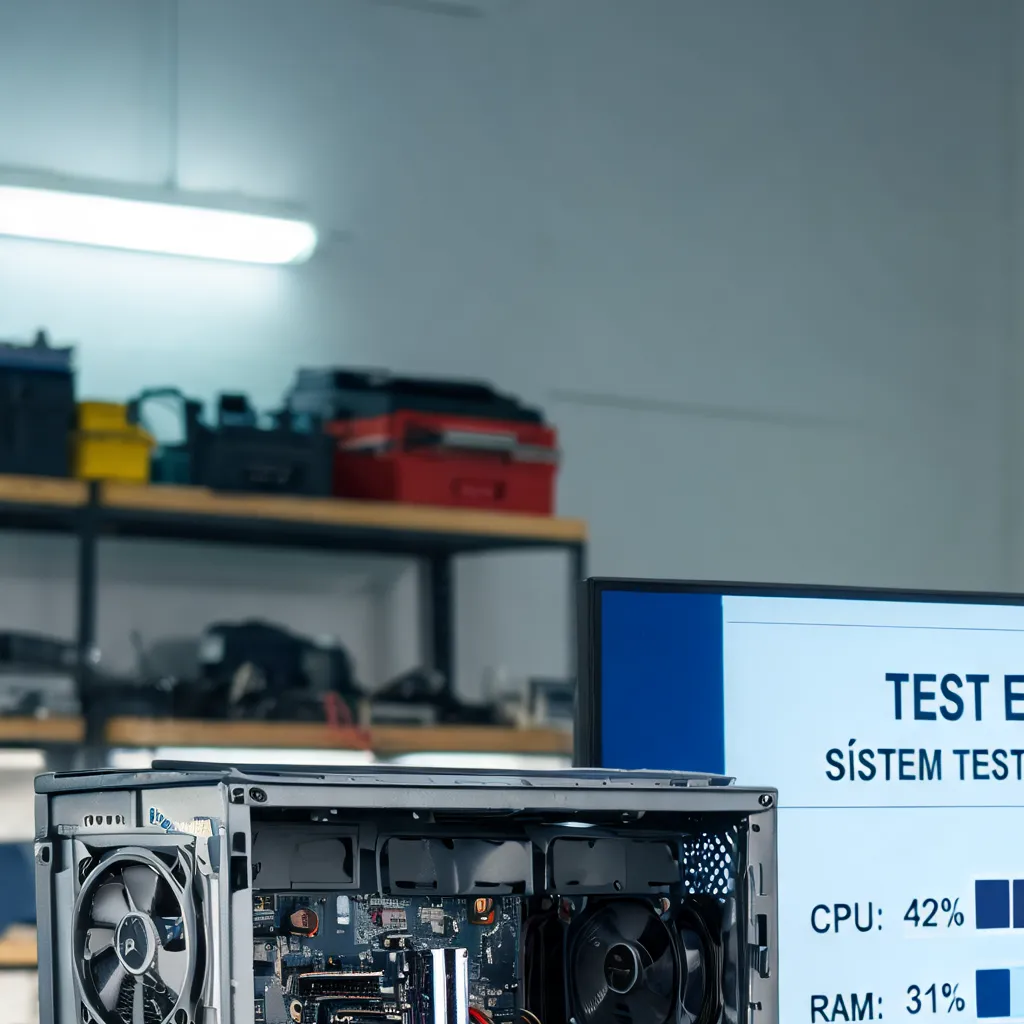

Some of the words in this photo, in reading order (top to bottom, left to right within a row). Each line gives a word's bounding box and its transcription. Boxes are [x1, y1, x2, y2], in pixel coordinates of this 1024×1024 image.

[886, 672, 990, 722] TEST
[810, 901, 883, 934] CPU:
[903, 897, 965, 928] 42%
[810, 992, 883, 1024] RAM:
[906, 982, 966, 1015] 31%
